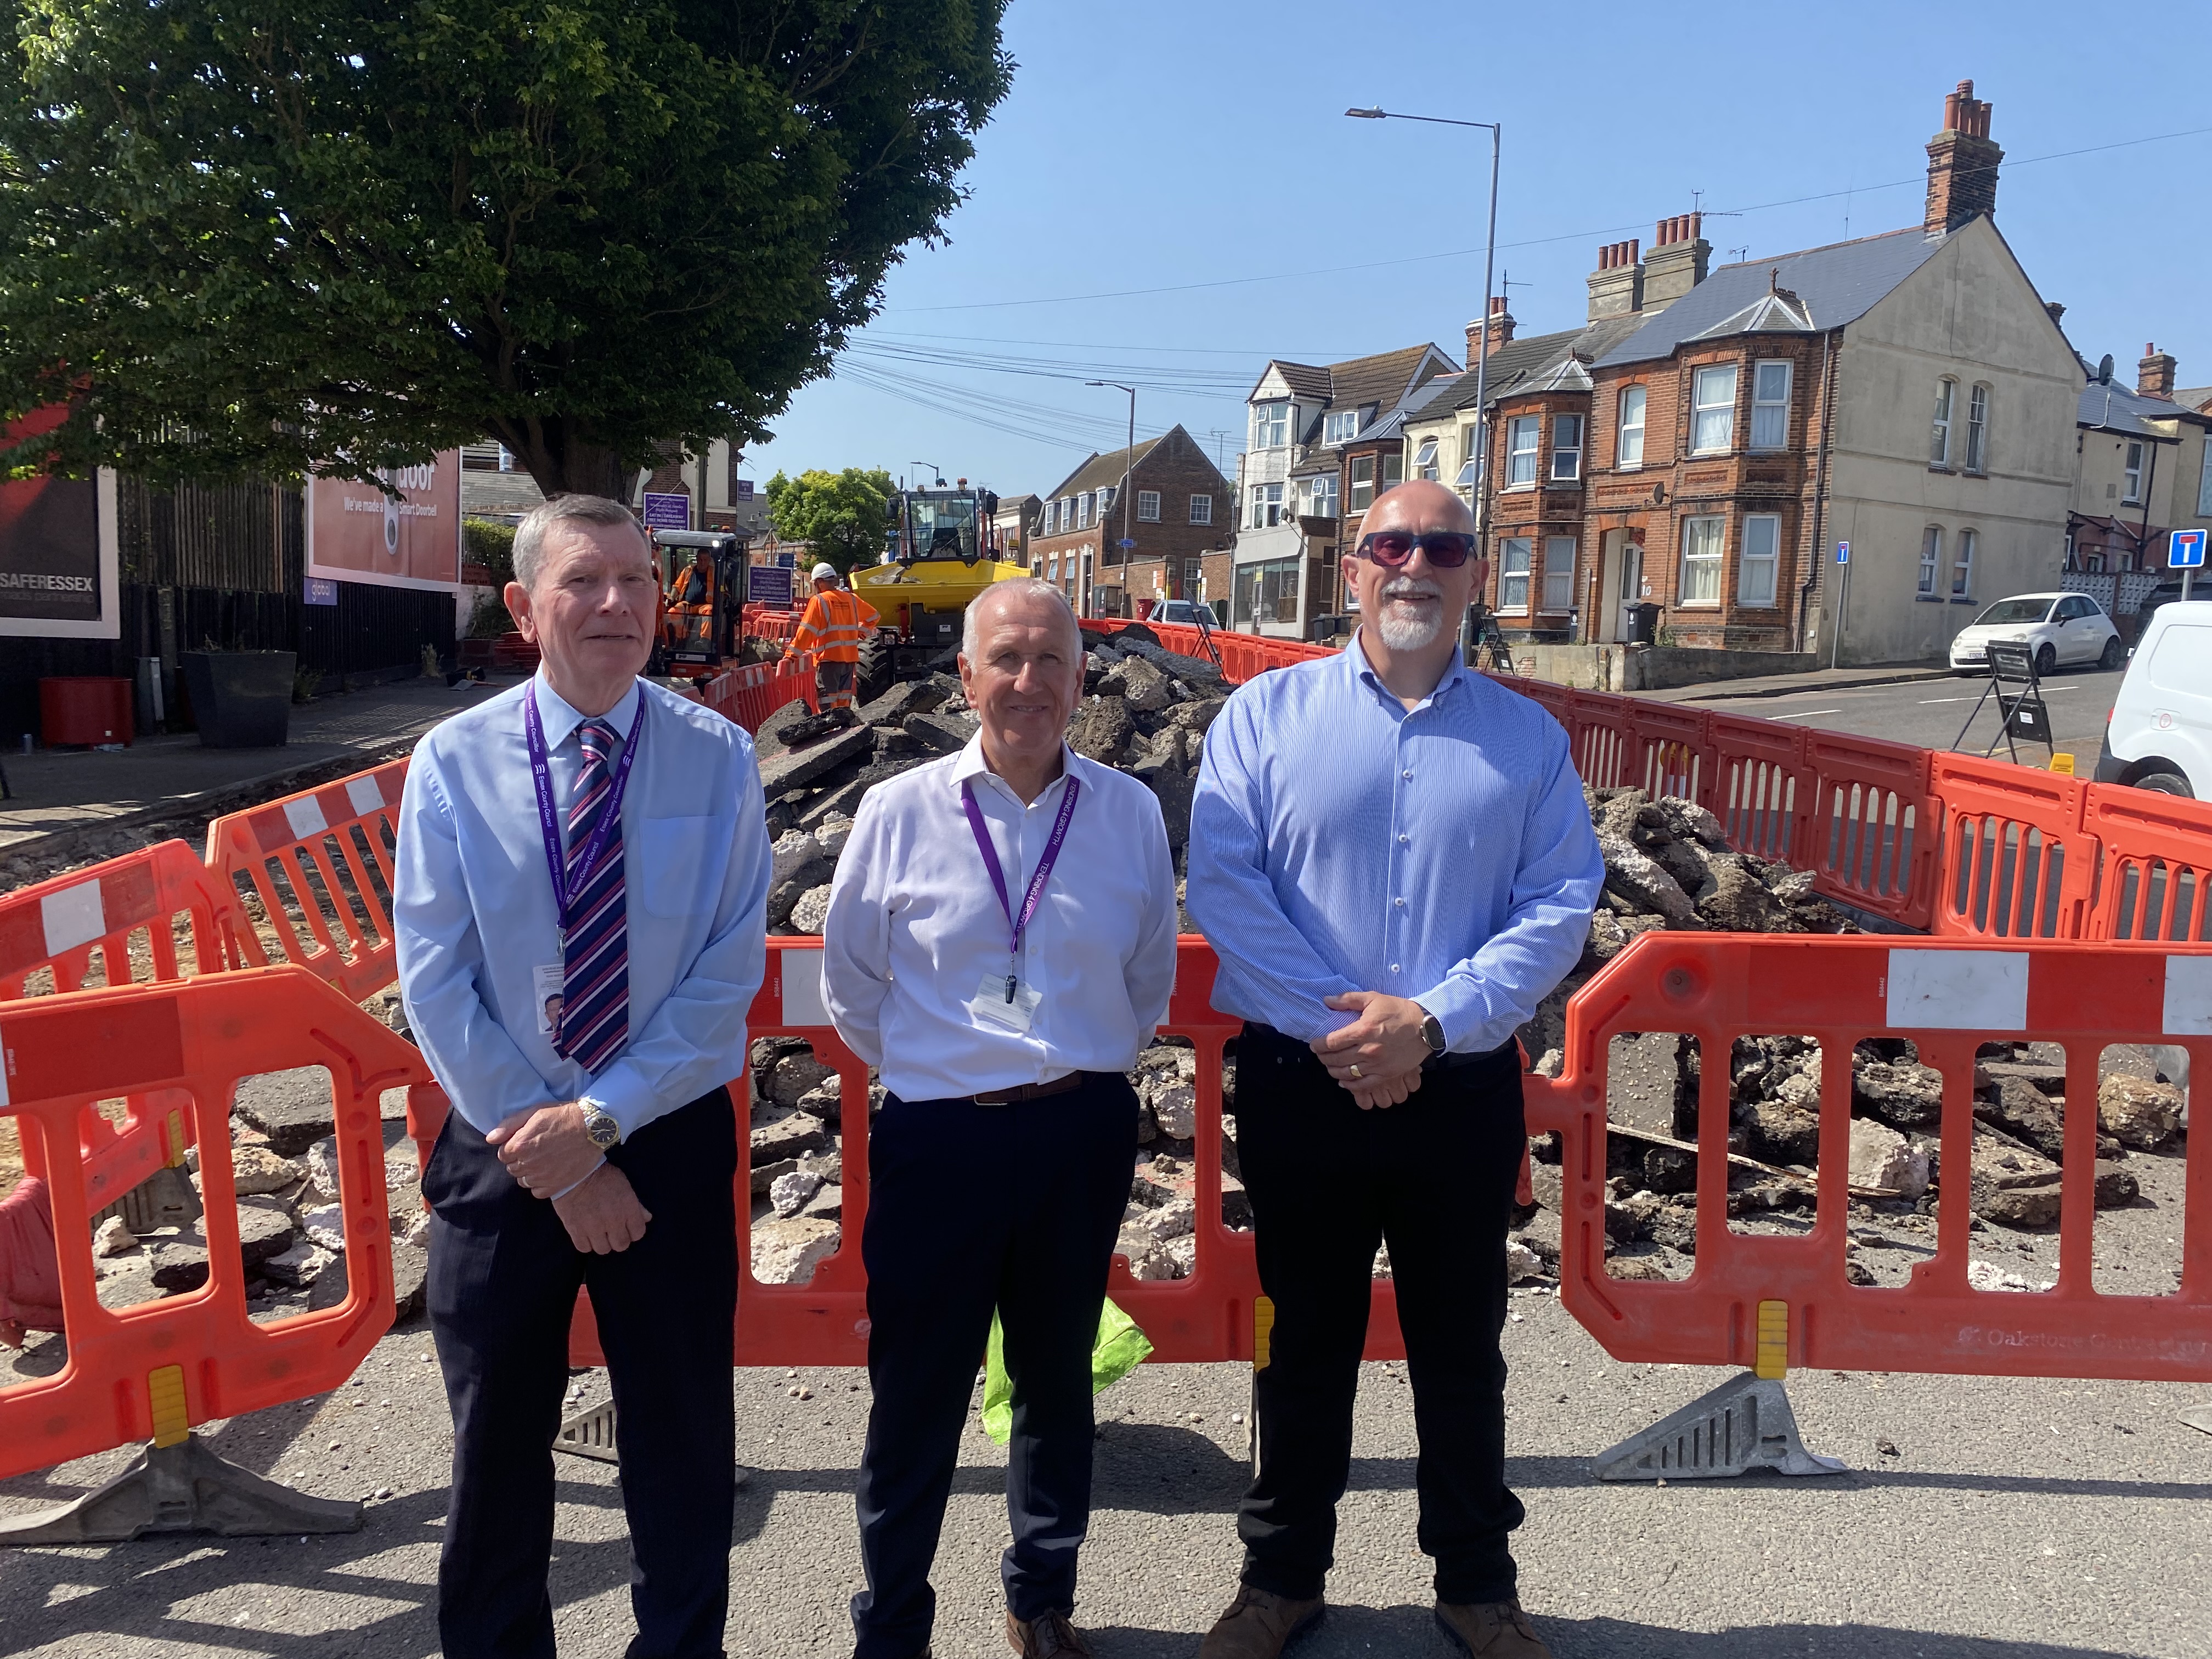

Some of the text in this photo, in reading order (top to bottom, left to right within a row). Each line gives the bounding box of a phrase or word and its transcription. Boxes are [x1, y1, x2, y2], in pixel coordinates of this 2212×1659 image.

[344, 496, 437, 517] We've made a Smart Doorbell
[0, 573, 93, 591] SAFERESSEX
[312, 580, 330, 602] global
[531, 727, 540, 753] Councillor
[600, 775, 623, 832] Essex County Councillor
[1063, 782, 1077, 812] TENDRING
[544, 809, 553, 827] Council
[1052, 816, 1067, 846] GROWTH
[572, 841, 600, 893] Essex County Council
[1030, 862, 1050, 896] TENDRING
